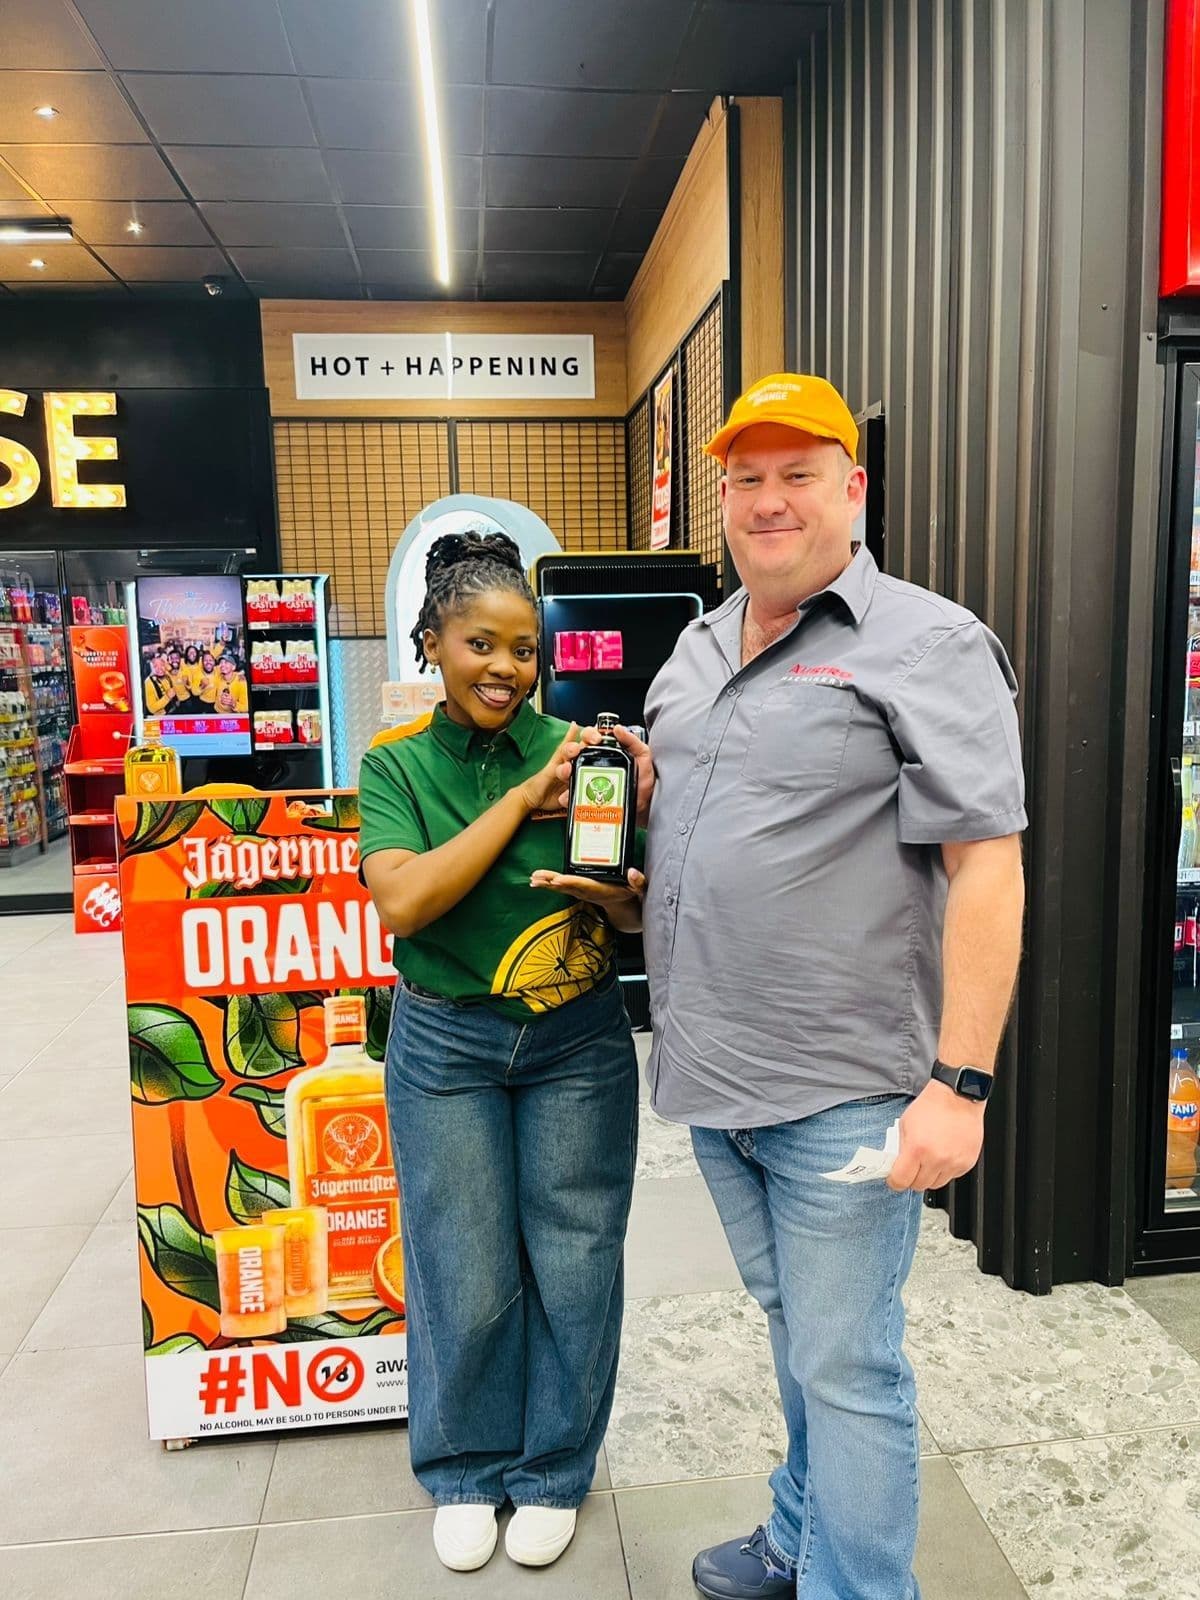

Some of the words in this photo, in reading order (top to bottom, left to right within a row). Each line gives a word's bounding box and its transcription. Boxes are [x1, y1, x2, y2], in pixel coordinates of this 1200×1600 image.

[310, 356, 369, 376] HOT
[406, 356, 579, 377] HAPPENING
[250, 601, 278, 609] CASTLE
[285, 600, 314, 609] CASTLE
[253, 661, 281, 670] CASTLE
[289, 660, 316, 669] CASTLE
[332, 1014, 359, 1025] RANGE
[327, 1208, 387, 1233] ORANGE
[238, 1247, 265, 1314] ORANGE
[376, 1380, 408, 1389] www.
[200, 1423, 212, 1431] NO
[214, 1420, 254, 1430] ALCOHOL
[256, 1417, 274, 1426] MAY
[275, 1416, 287, 1424] BE
[289, 1413, 311, 1423] SOLD
[314, 1412, 324, 1420] TO
[325, 1408, 366, 1419] PERSONS
[367, 1405, 396, 1415] UNDER
